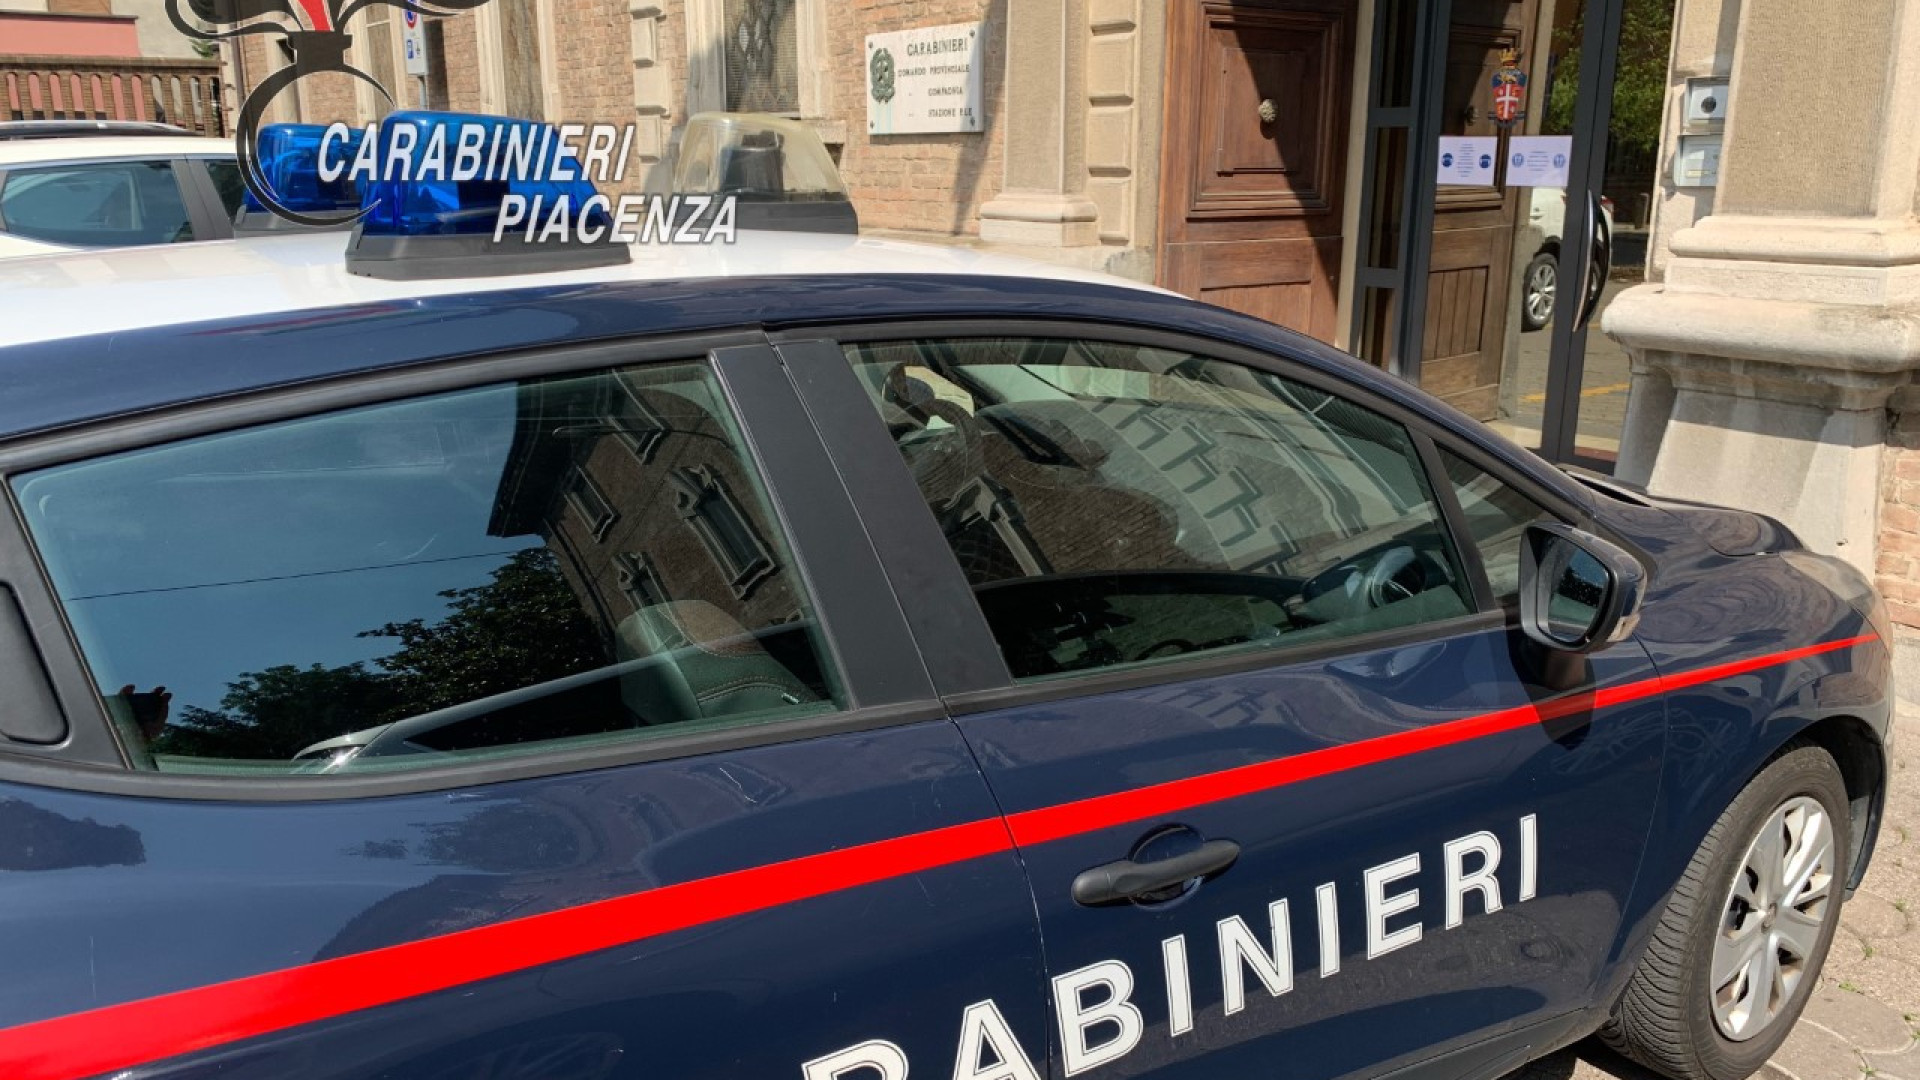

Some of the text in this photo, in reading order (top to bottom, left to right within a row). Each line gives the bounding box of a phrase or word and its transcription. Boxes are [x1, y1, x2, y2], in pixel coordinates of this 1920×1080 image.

[907, 38, 968, 55] CARABINIERI
[898, 65, 970, 77] COMANDO PROVINCIALE
[928, 87, 962, 96] COMPAGNIA
[928, 108, 957, 117] STAZIONE
